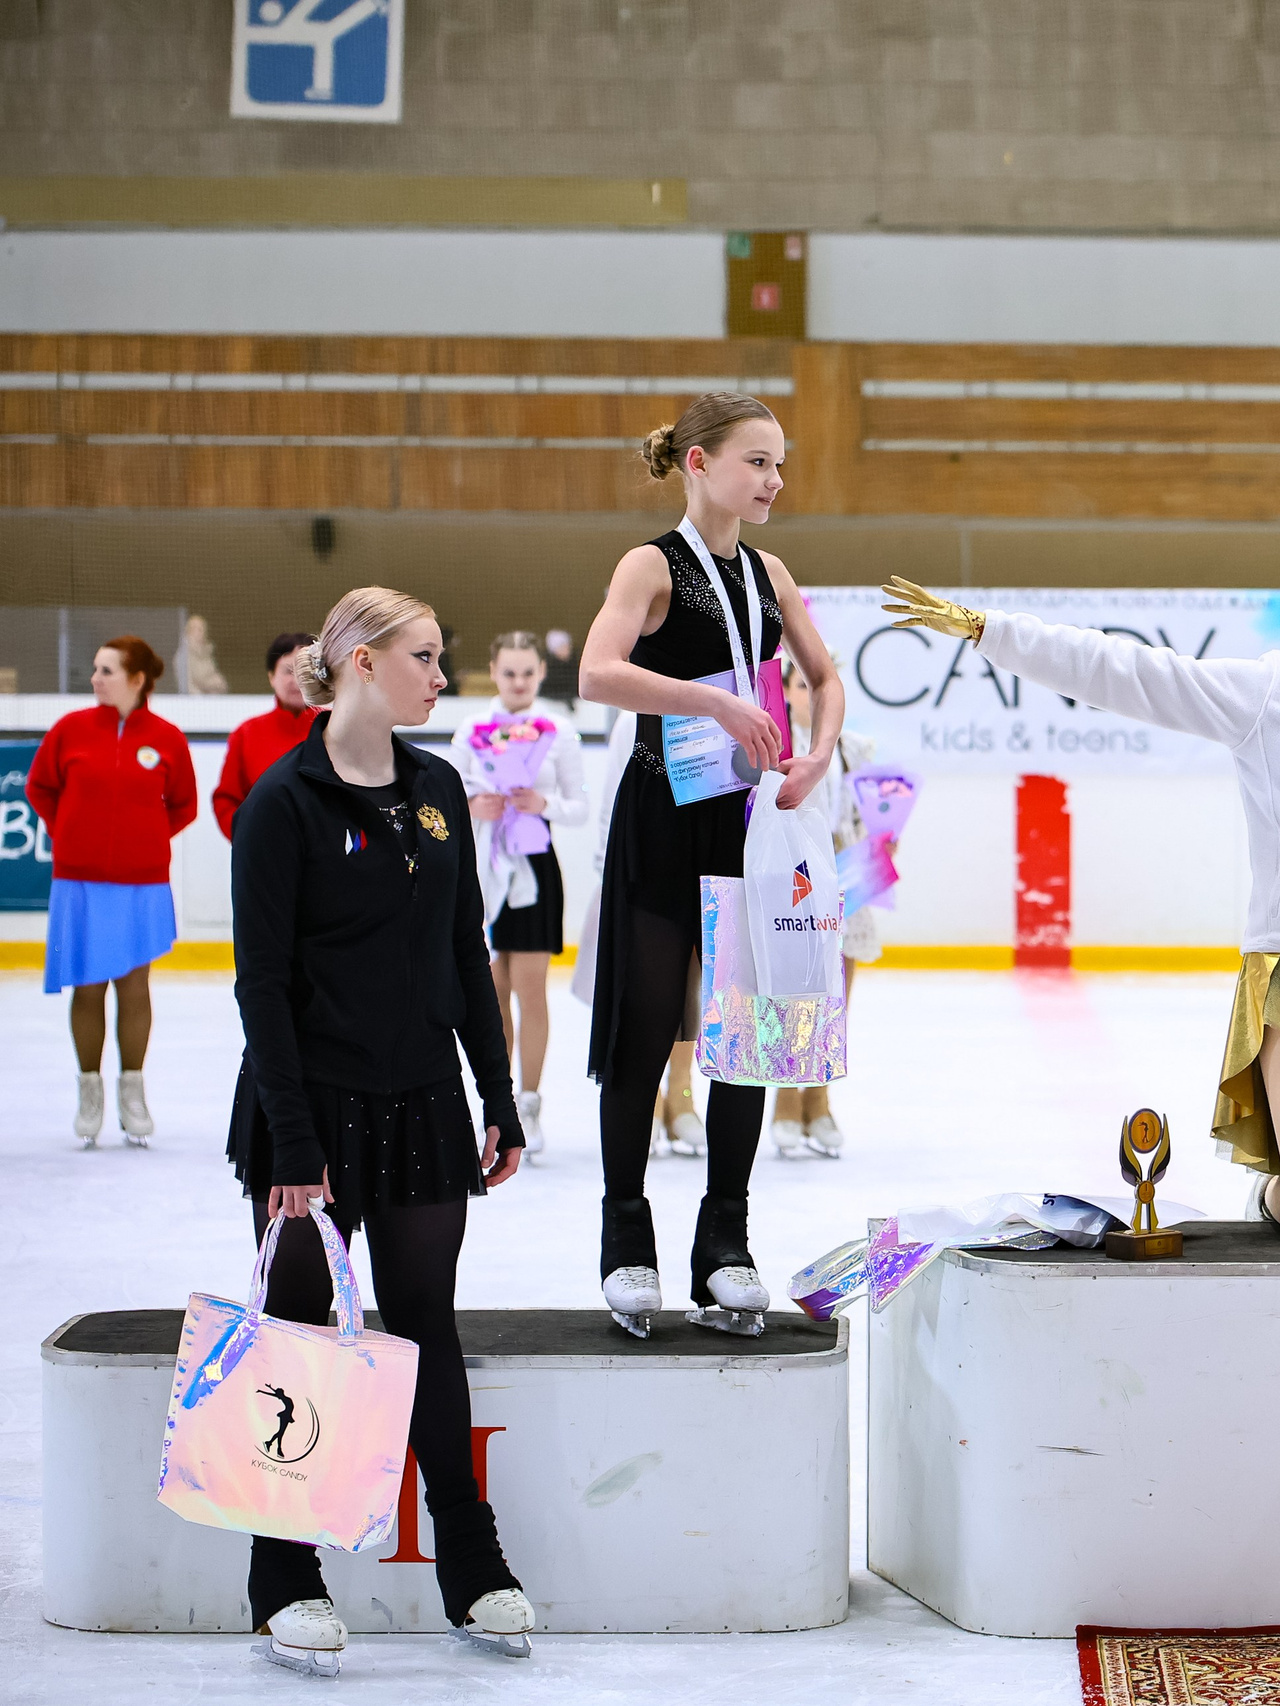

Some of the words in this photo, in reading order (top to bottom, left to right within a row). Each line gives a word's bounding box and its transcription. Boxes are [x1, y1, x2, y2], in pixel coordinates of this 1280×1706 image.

[921, 723, 993, 752] kids
[1007, 723, 1031, 752] &
[1046, 724, 1151, 753] teens
[773, 914, 838, 931] smartavia
[251, 1459, 278, 1475] КУБОК
[279, 1468, 308, 1482] CANDY
